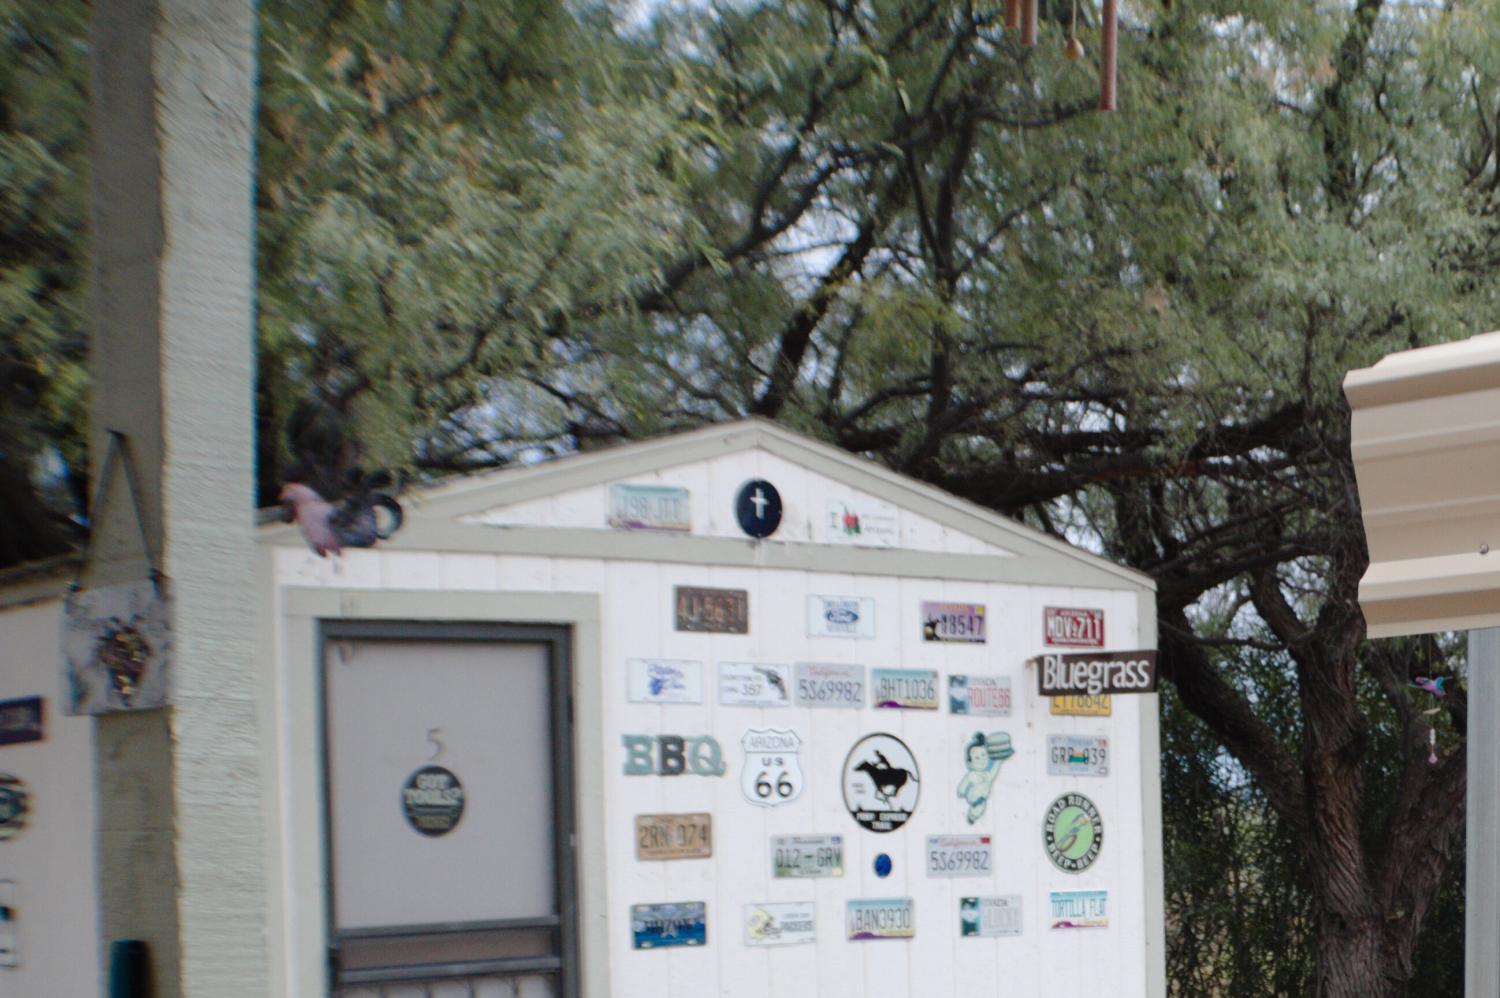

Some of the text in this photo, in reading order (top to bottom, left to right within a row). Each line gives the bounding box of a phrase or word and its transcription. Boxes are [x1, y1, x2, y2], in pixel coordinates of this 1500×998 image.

[1044, 655, 1149, 695] Bluegrass
[622, 735, 726, 776] BBQ
[761, 756, 785, 767] US
[754, 770, 794, 799] 66
[1046, 799, 1067, 832] ROAD
